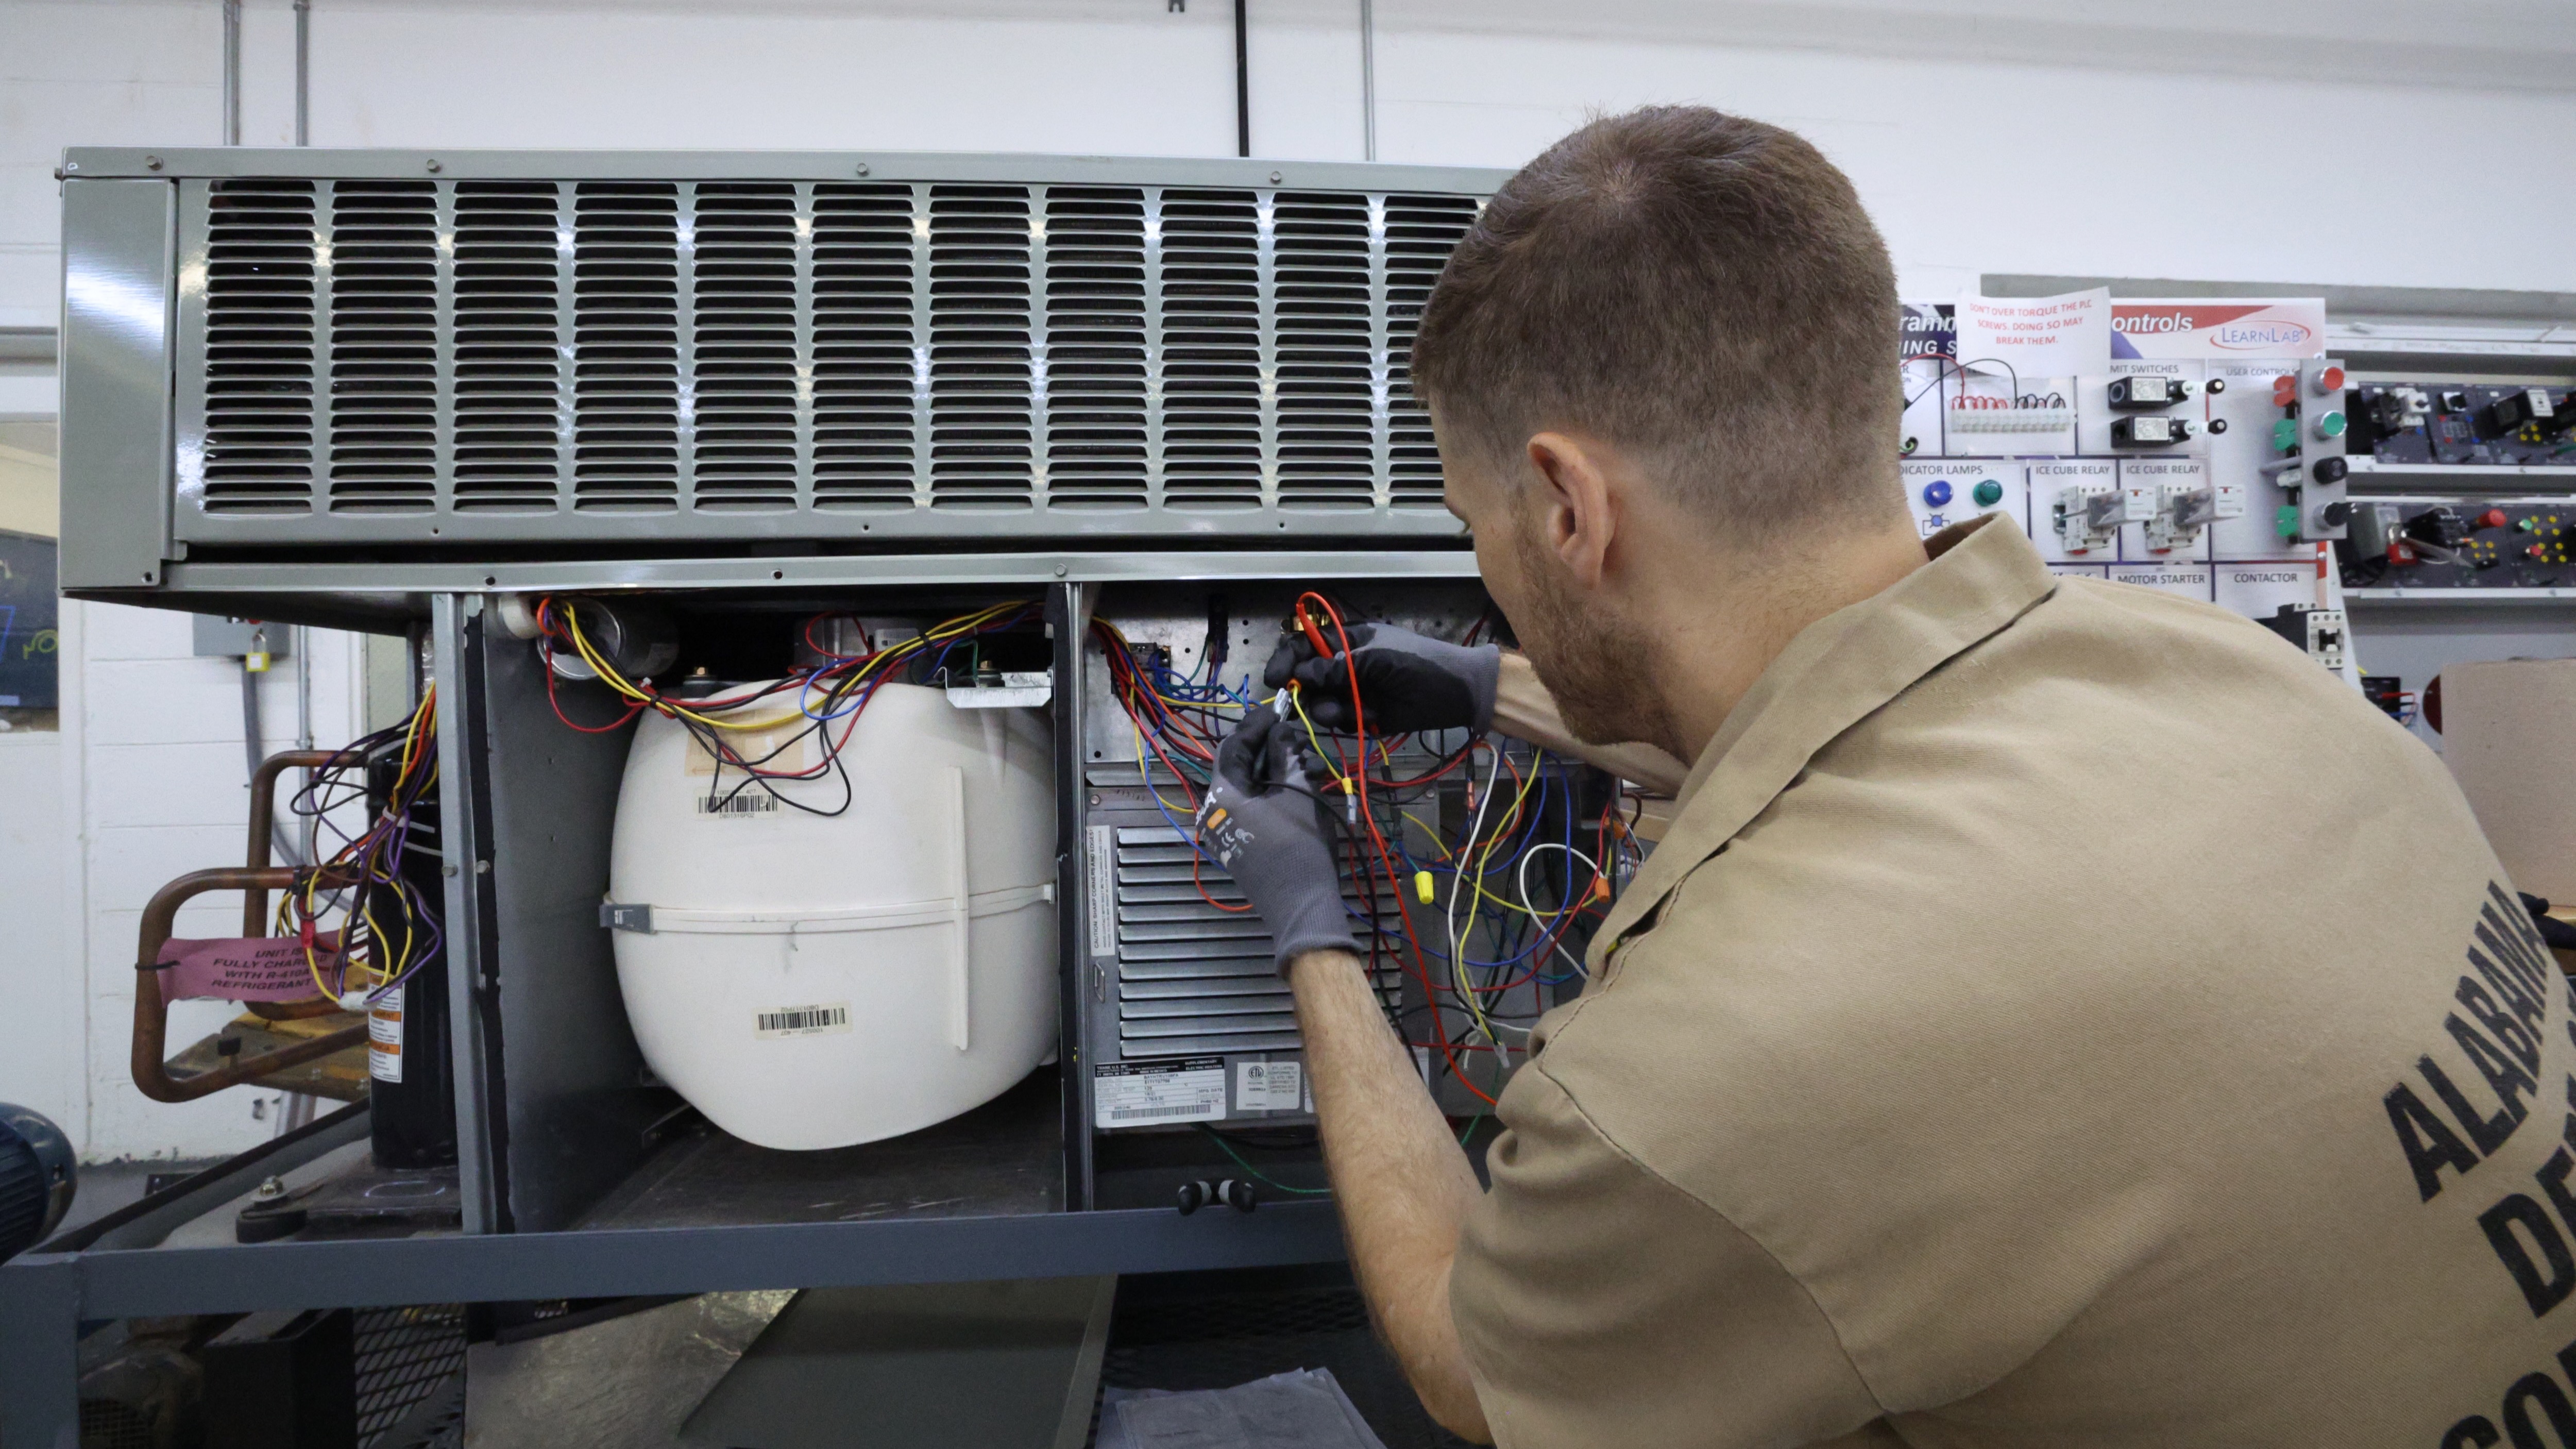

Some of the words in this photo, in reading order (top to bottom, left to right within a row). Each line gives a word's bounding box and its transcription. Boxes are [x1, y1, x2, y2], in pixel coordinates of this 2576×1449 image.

[1970, 303, 1990, 313] DON'T
[1992, 308, 2014, 316] OVER
[2018, 305, 2058, 317] TORQUE
[2061, 302, 2077, 312] THE
[2079, 299, 2092, 309] PLC
[1977, 319, 2010, 330] SCREWS.
[2012, 323, 2043, 331] DOING
[2047, 321, 2060, 330] SO
[2063, 316, 2083, 327] MAY
[2112, 312, 2193, 332] ontrols
[1996, 336, 2024, 344] BREAK
[2027, 335, 2058, 345] THEM.
[1900, 340, 1937, 355] ING
[2131, 365, 2179, 373] SWITCHES
[1946, 465, 1983, 474] LAMPS
[2036, 466, 2050, 474] ICE
[2053, 466, 2078, 474] CUBE
[2081, 466, 2109, 474] RELAY
[2127, 465, 2141, 474] ICE
[2143, 465, 2168, 474] CUBE
[2172, 465, 2200, 474] RELAY
[2117, 575, 2157, 584] MOTOR
[2161, 574, 2205, 584] STARTER
[2234, 574, 2297, 583] CONTACTOR
[256, 949, 289, 958] UNIT
[213, 958, 261, 968] FULLY
[264, 955, 328, 969] CHARD
[266, 969, 309, 979] R-410A
[211, 978, 313, 990] REFRIGERANT
[2382, 880, 2548, 1202] ALABAMA
